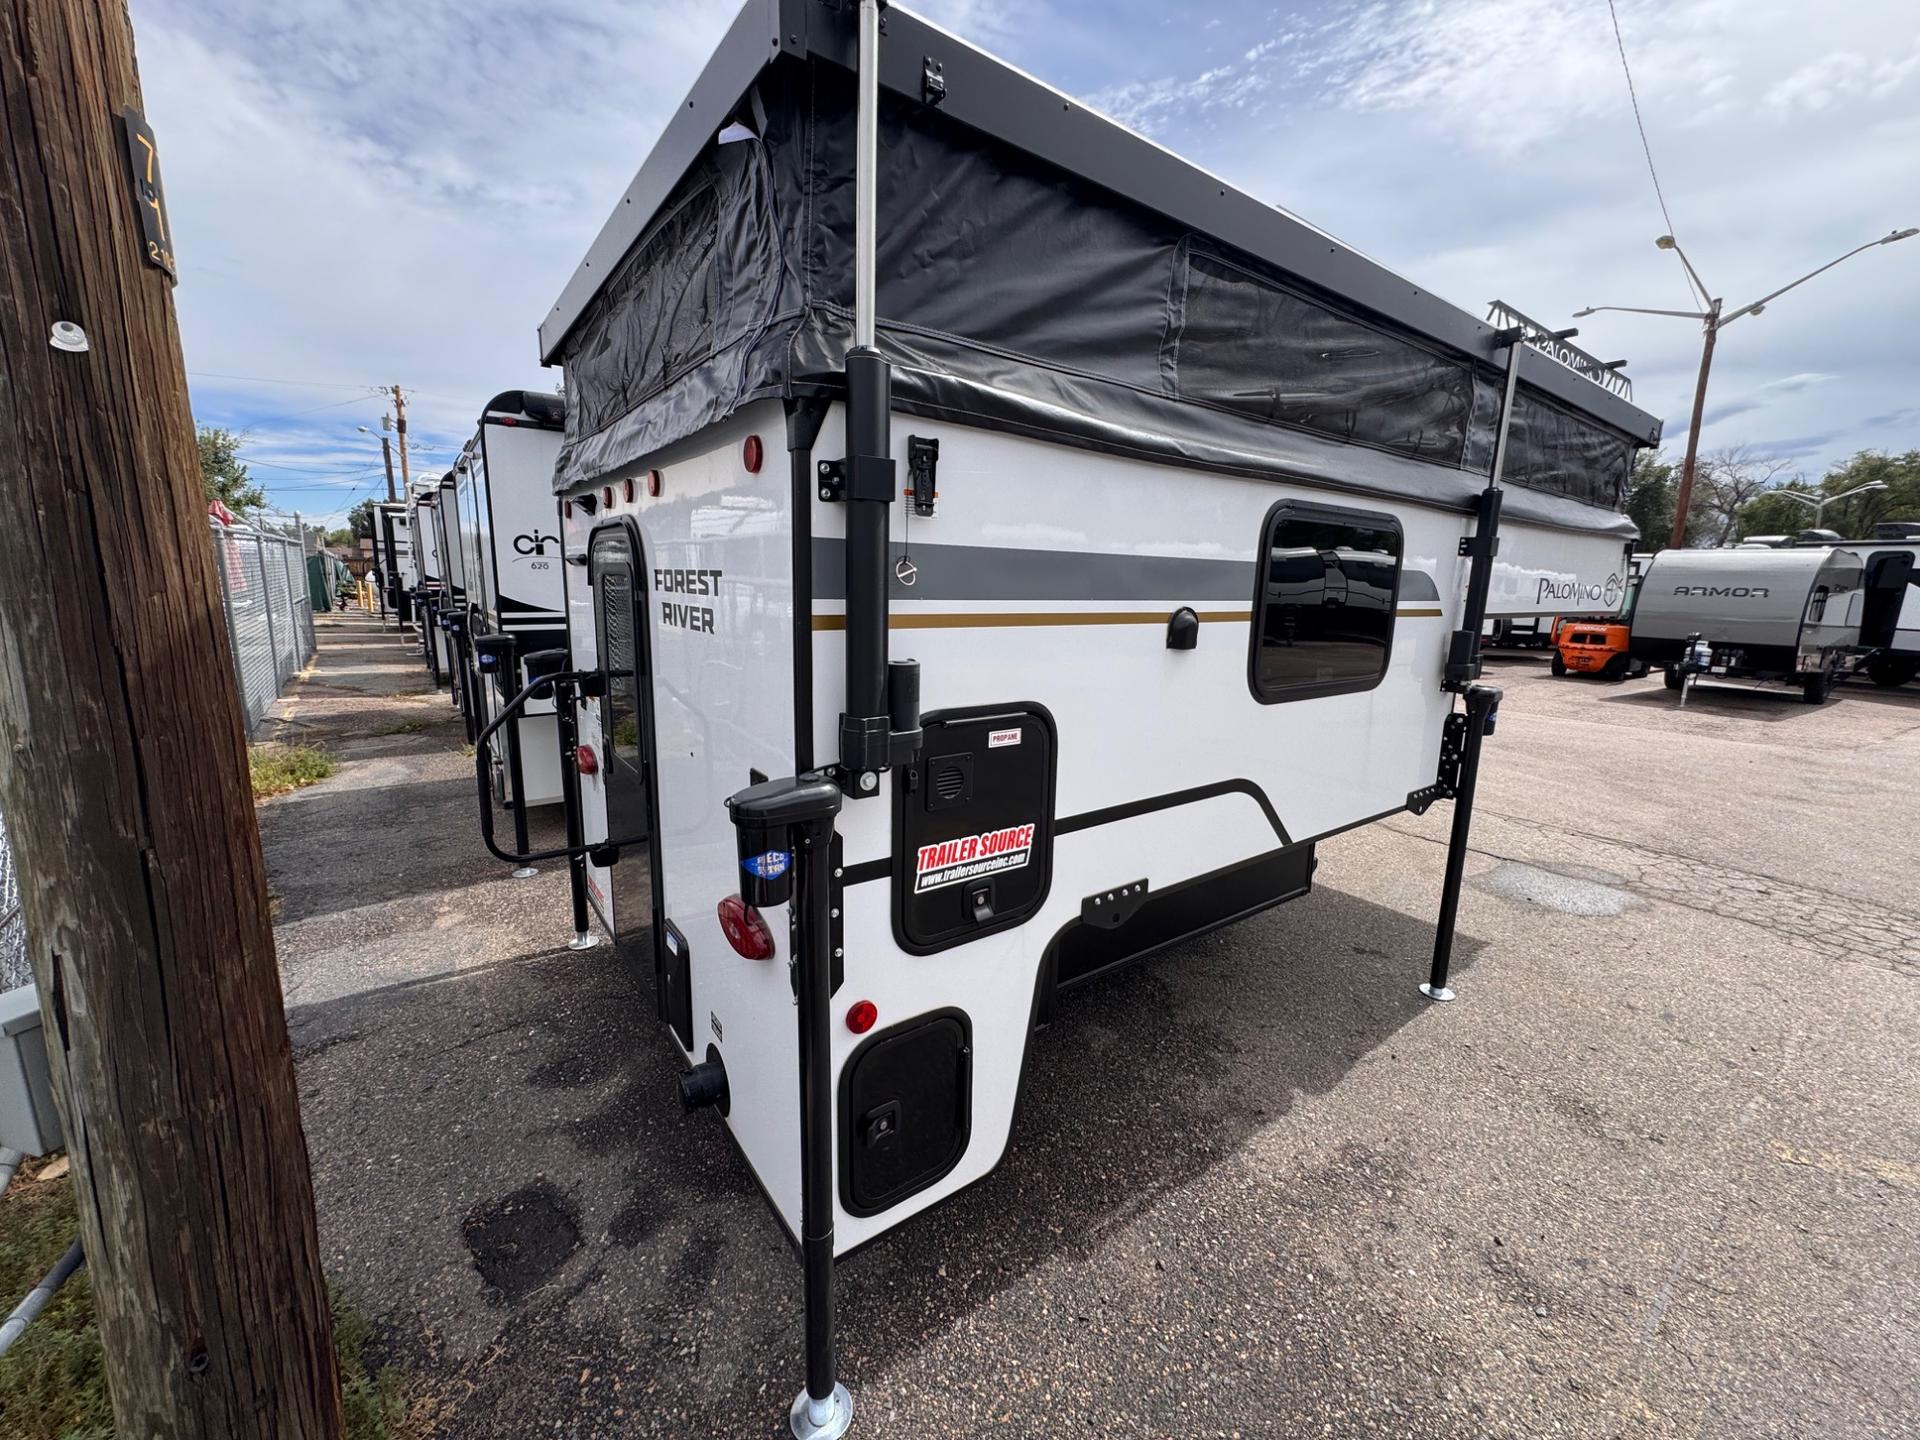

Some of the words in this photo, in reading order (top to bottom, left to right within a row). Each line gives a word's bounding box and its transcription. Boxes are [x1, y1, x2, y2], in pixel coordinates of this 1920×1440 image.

[530, 561, 550, 570] 620
[654, 568, 723, 597] FOREST
[1535, 577, 1602, 607] PALOMINO
[1673, 586, 1770, 598] ARMOR
[661, 601, 715, 635] RIVER
[992, 732, 1018, 743] PROPANE
[919, 837, 979, 872] TRAILER
[979, 825, 1033, 857] SOURCE
[920, 852, 1027, 888] www.trailersourceinc.com
